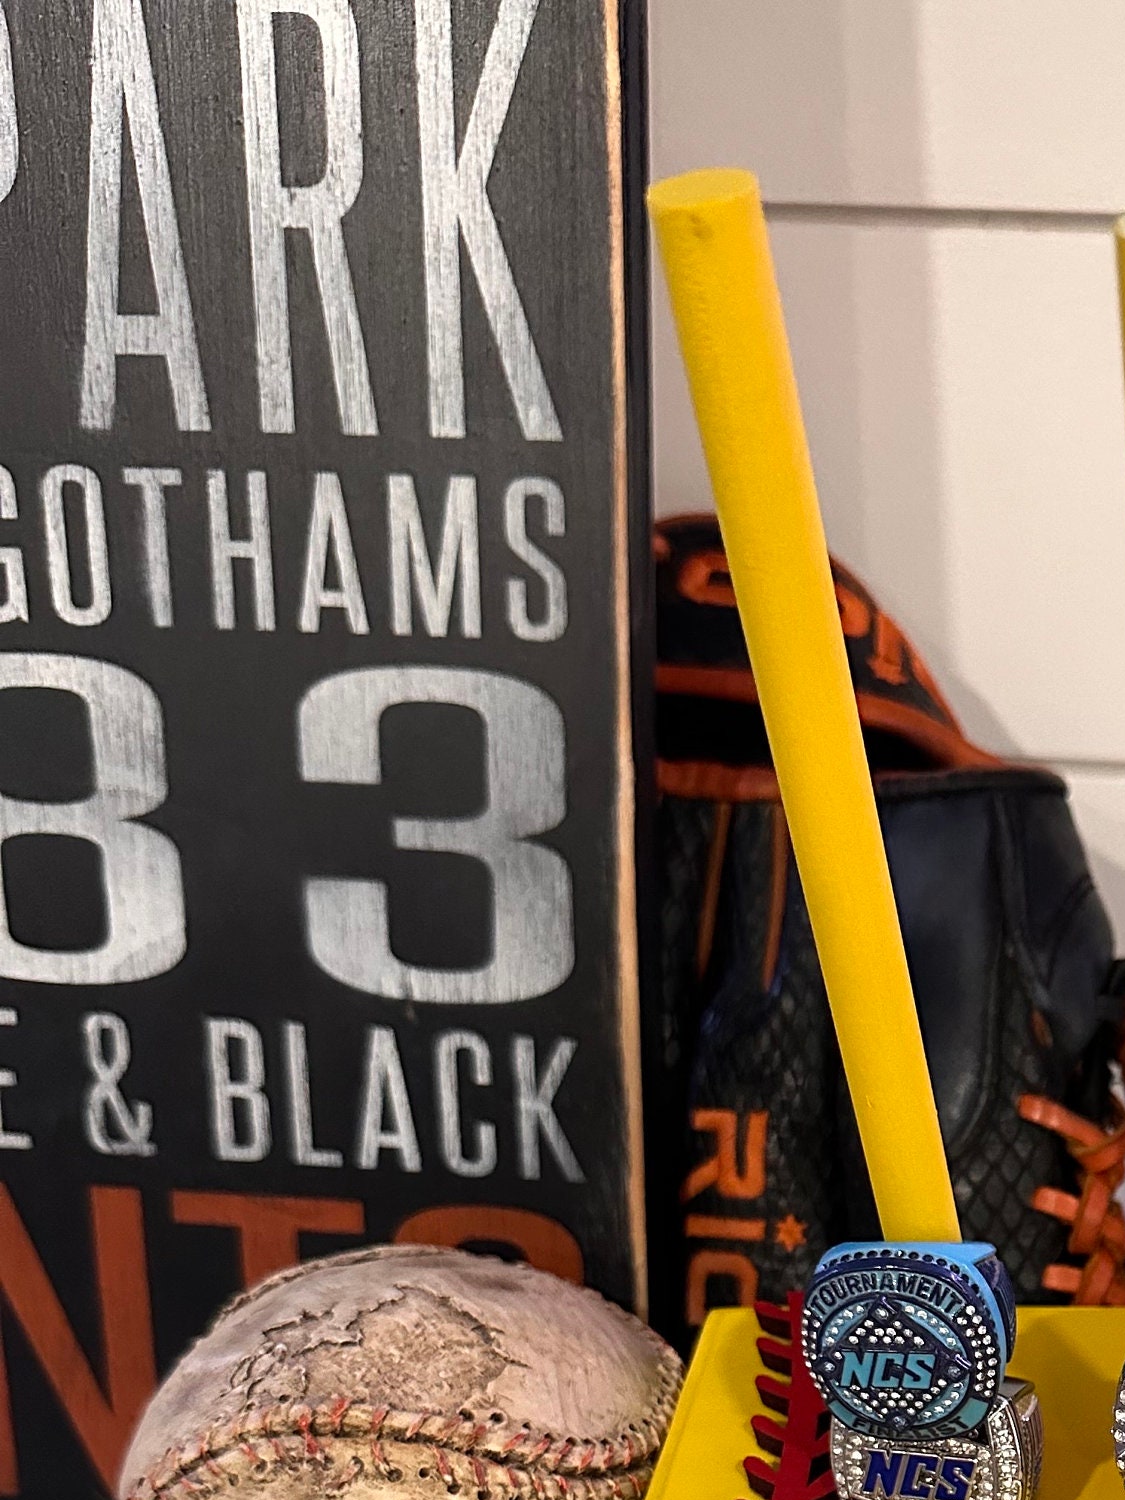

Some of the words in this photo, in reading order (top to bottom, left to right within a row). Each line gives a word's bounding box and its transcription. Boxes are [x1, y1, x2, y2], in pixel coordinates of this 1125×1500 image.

[0, 0, 564, 442] ARK
[83, 1010, 158, 1157] &
[203, 1014, 588, 1185] BLACK
[810, 1270, 966, 1317] TOURNAMENT
[839, 1350, 937, 1390] NCS
